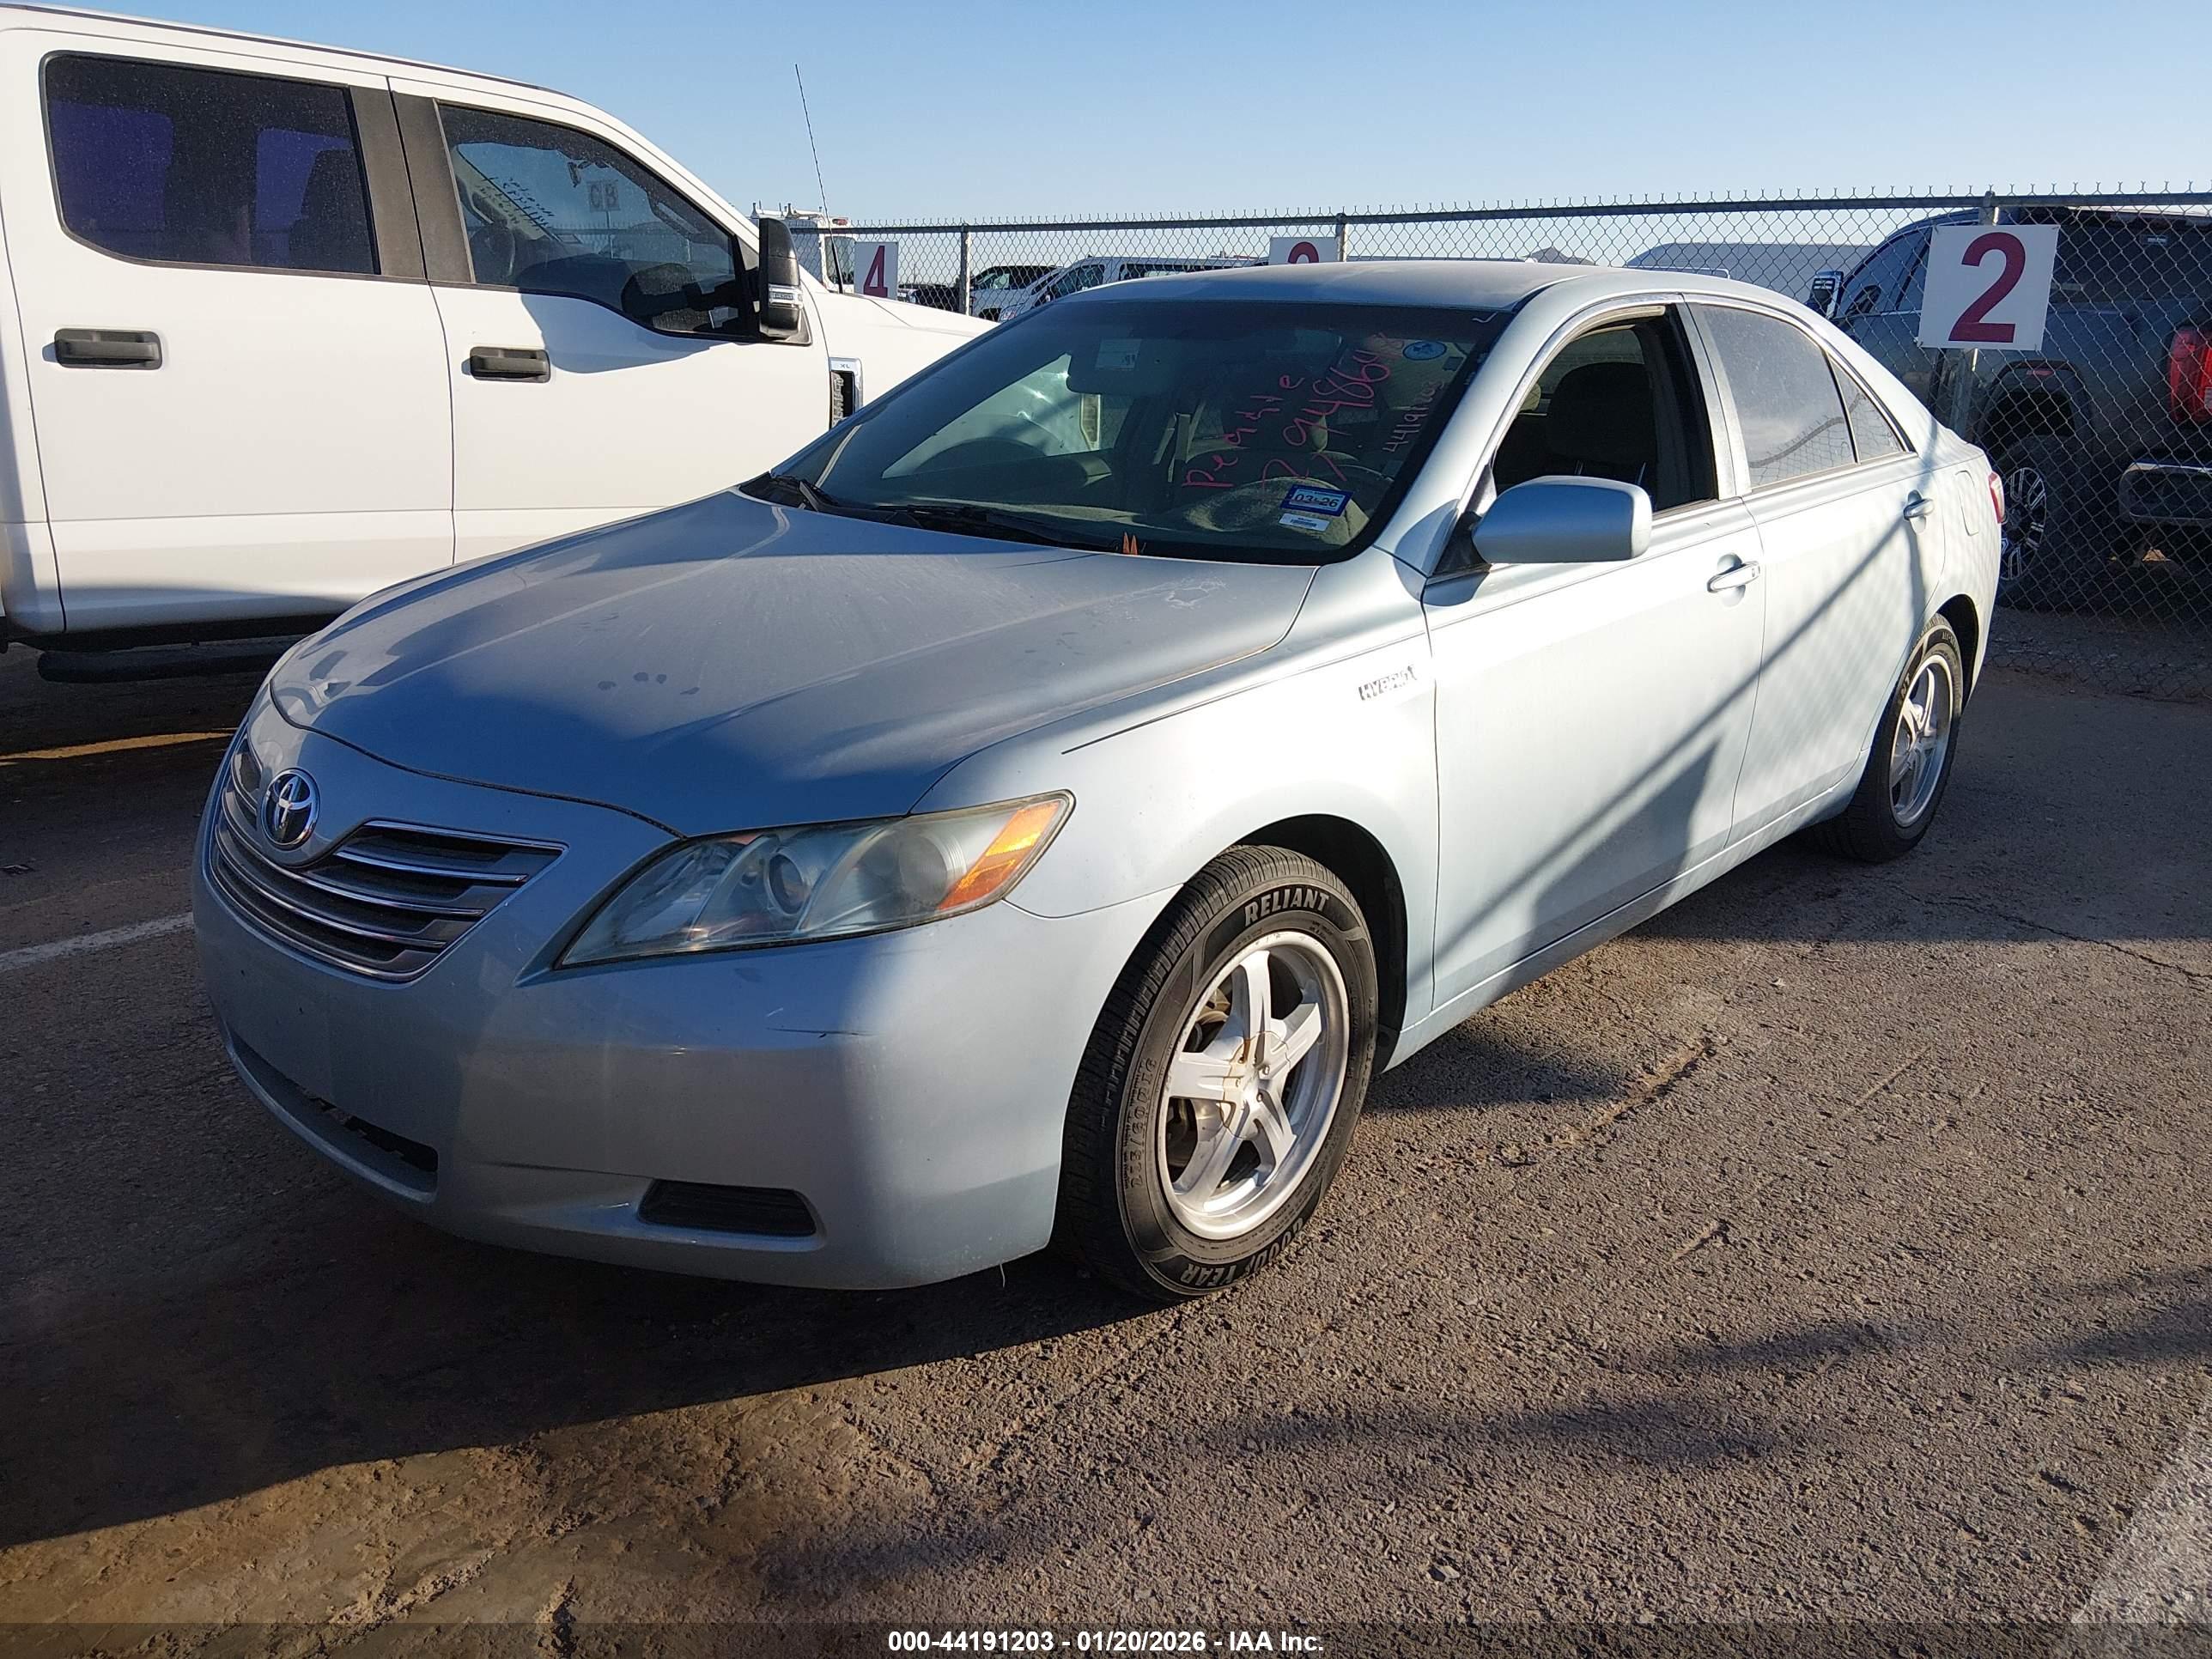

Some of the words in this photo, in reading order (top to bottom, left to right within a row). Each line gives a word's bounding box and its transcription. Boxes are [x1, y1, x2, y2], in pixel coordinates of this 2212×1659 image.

[863, 245, 888, 298] 4
[1948, 232, 2026, 343] 2
[1244, 888, 1330, 927] RELIANT
